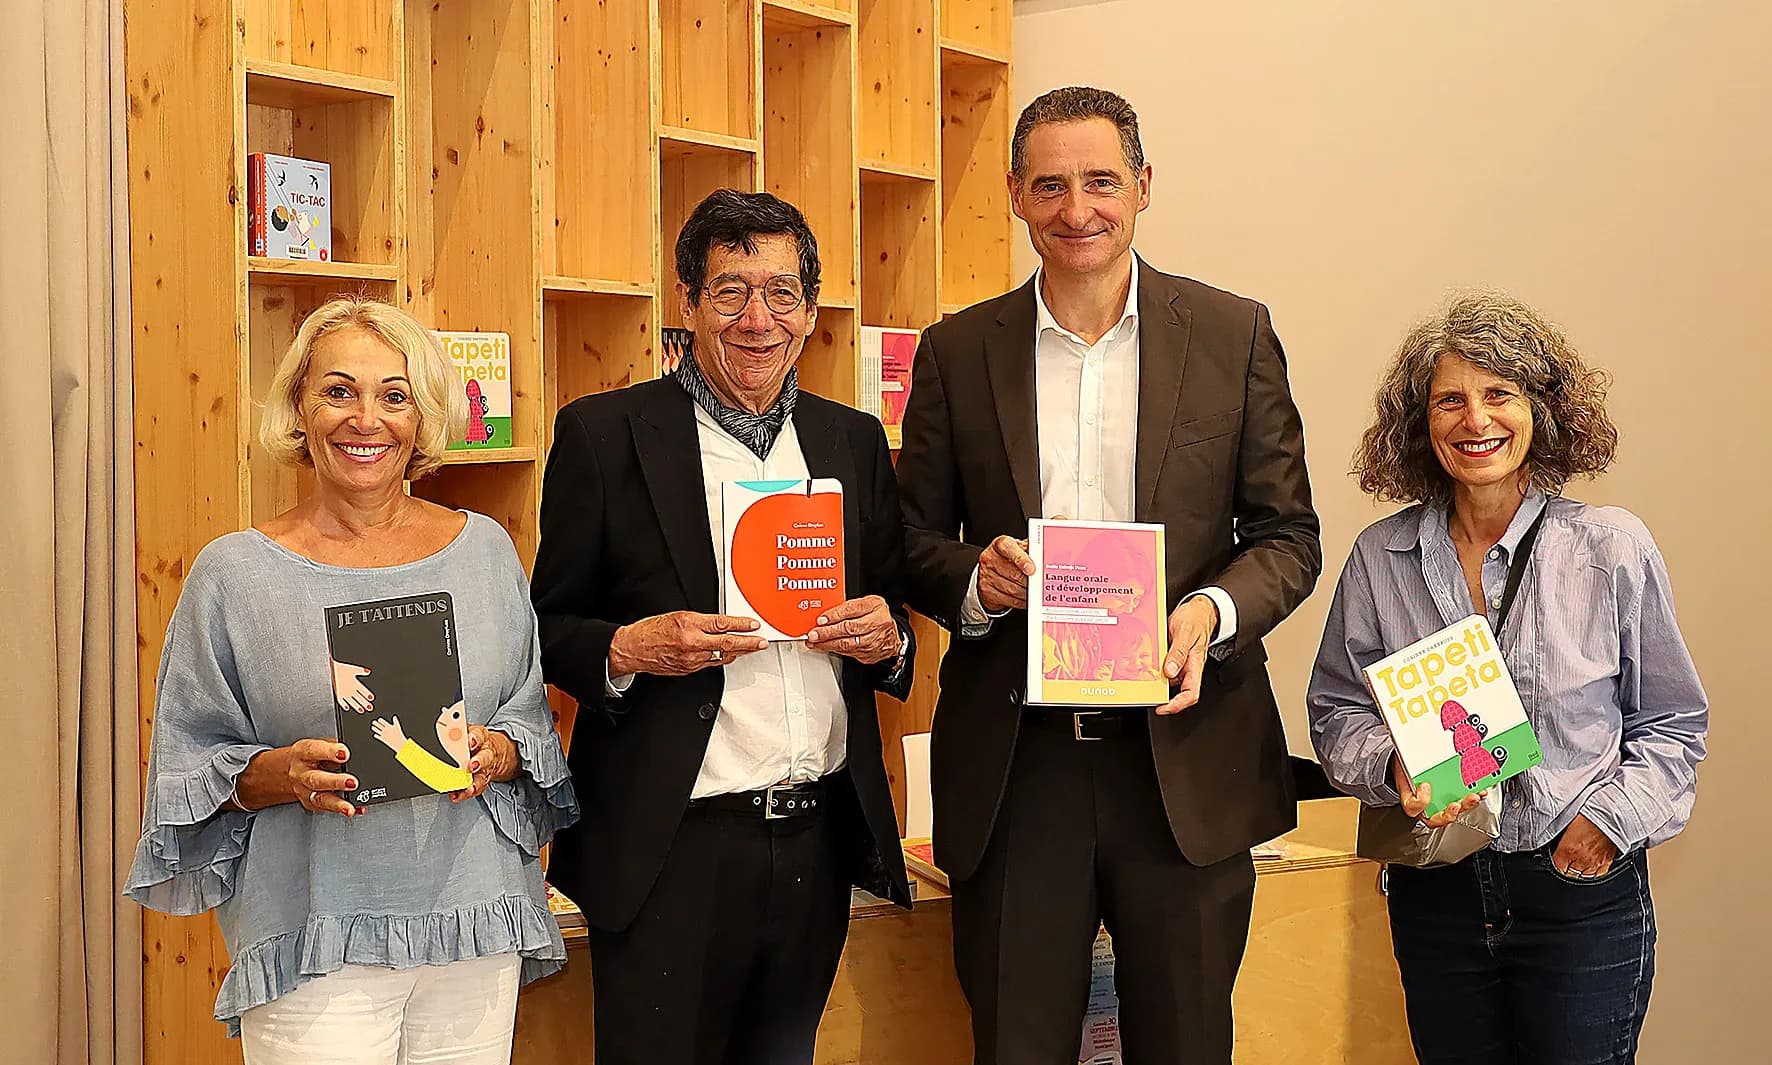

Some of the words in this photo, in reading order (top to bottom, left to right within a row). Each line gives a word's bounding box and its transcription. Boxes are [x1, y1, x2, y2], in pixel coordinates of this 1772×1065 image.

[290, 192, 326, 207] TIC-TAC
[441, 336, 506, 364] Tapeti
[456, 361, 507, 384] peta
[776, 534, 836, 549] Pomme
[777, 555, 837, 570] Pomme
[777, 576, 837, 591] Pomme
[1045, 573, 1081, 583] Langue
[1083, 575, 1109, 583] orale
[1056, 583, 1134, 595] développement
[1045, 594, 1057, 602] de
[1059, 594, 1099, 604] l'enfant
[337, 611, 355, 628] JE
[359, 599, 448, 623] T'ATTENDS
[1376, 623, 1491, 698] Tapeti
[1388, 659, 1502, 725] Tapeta
